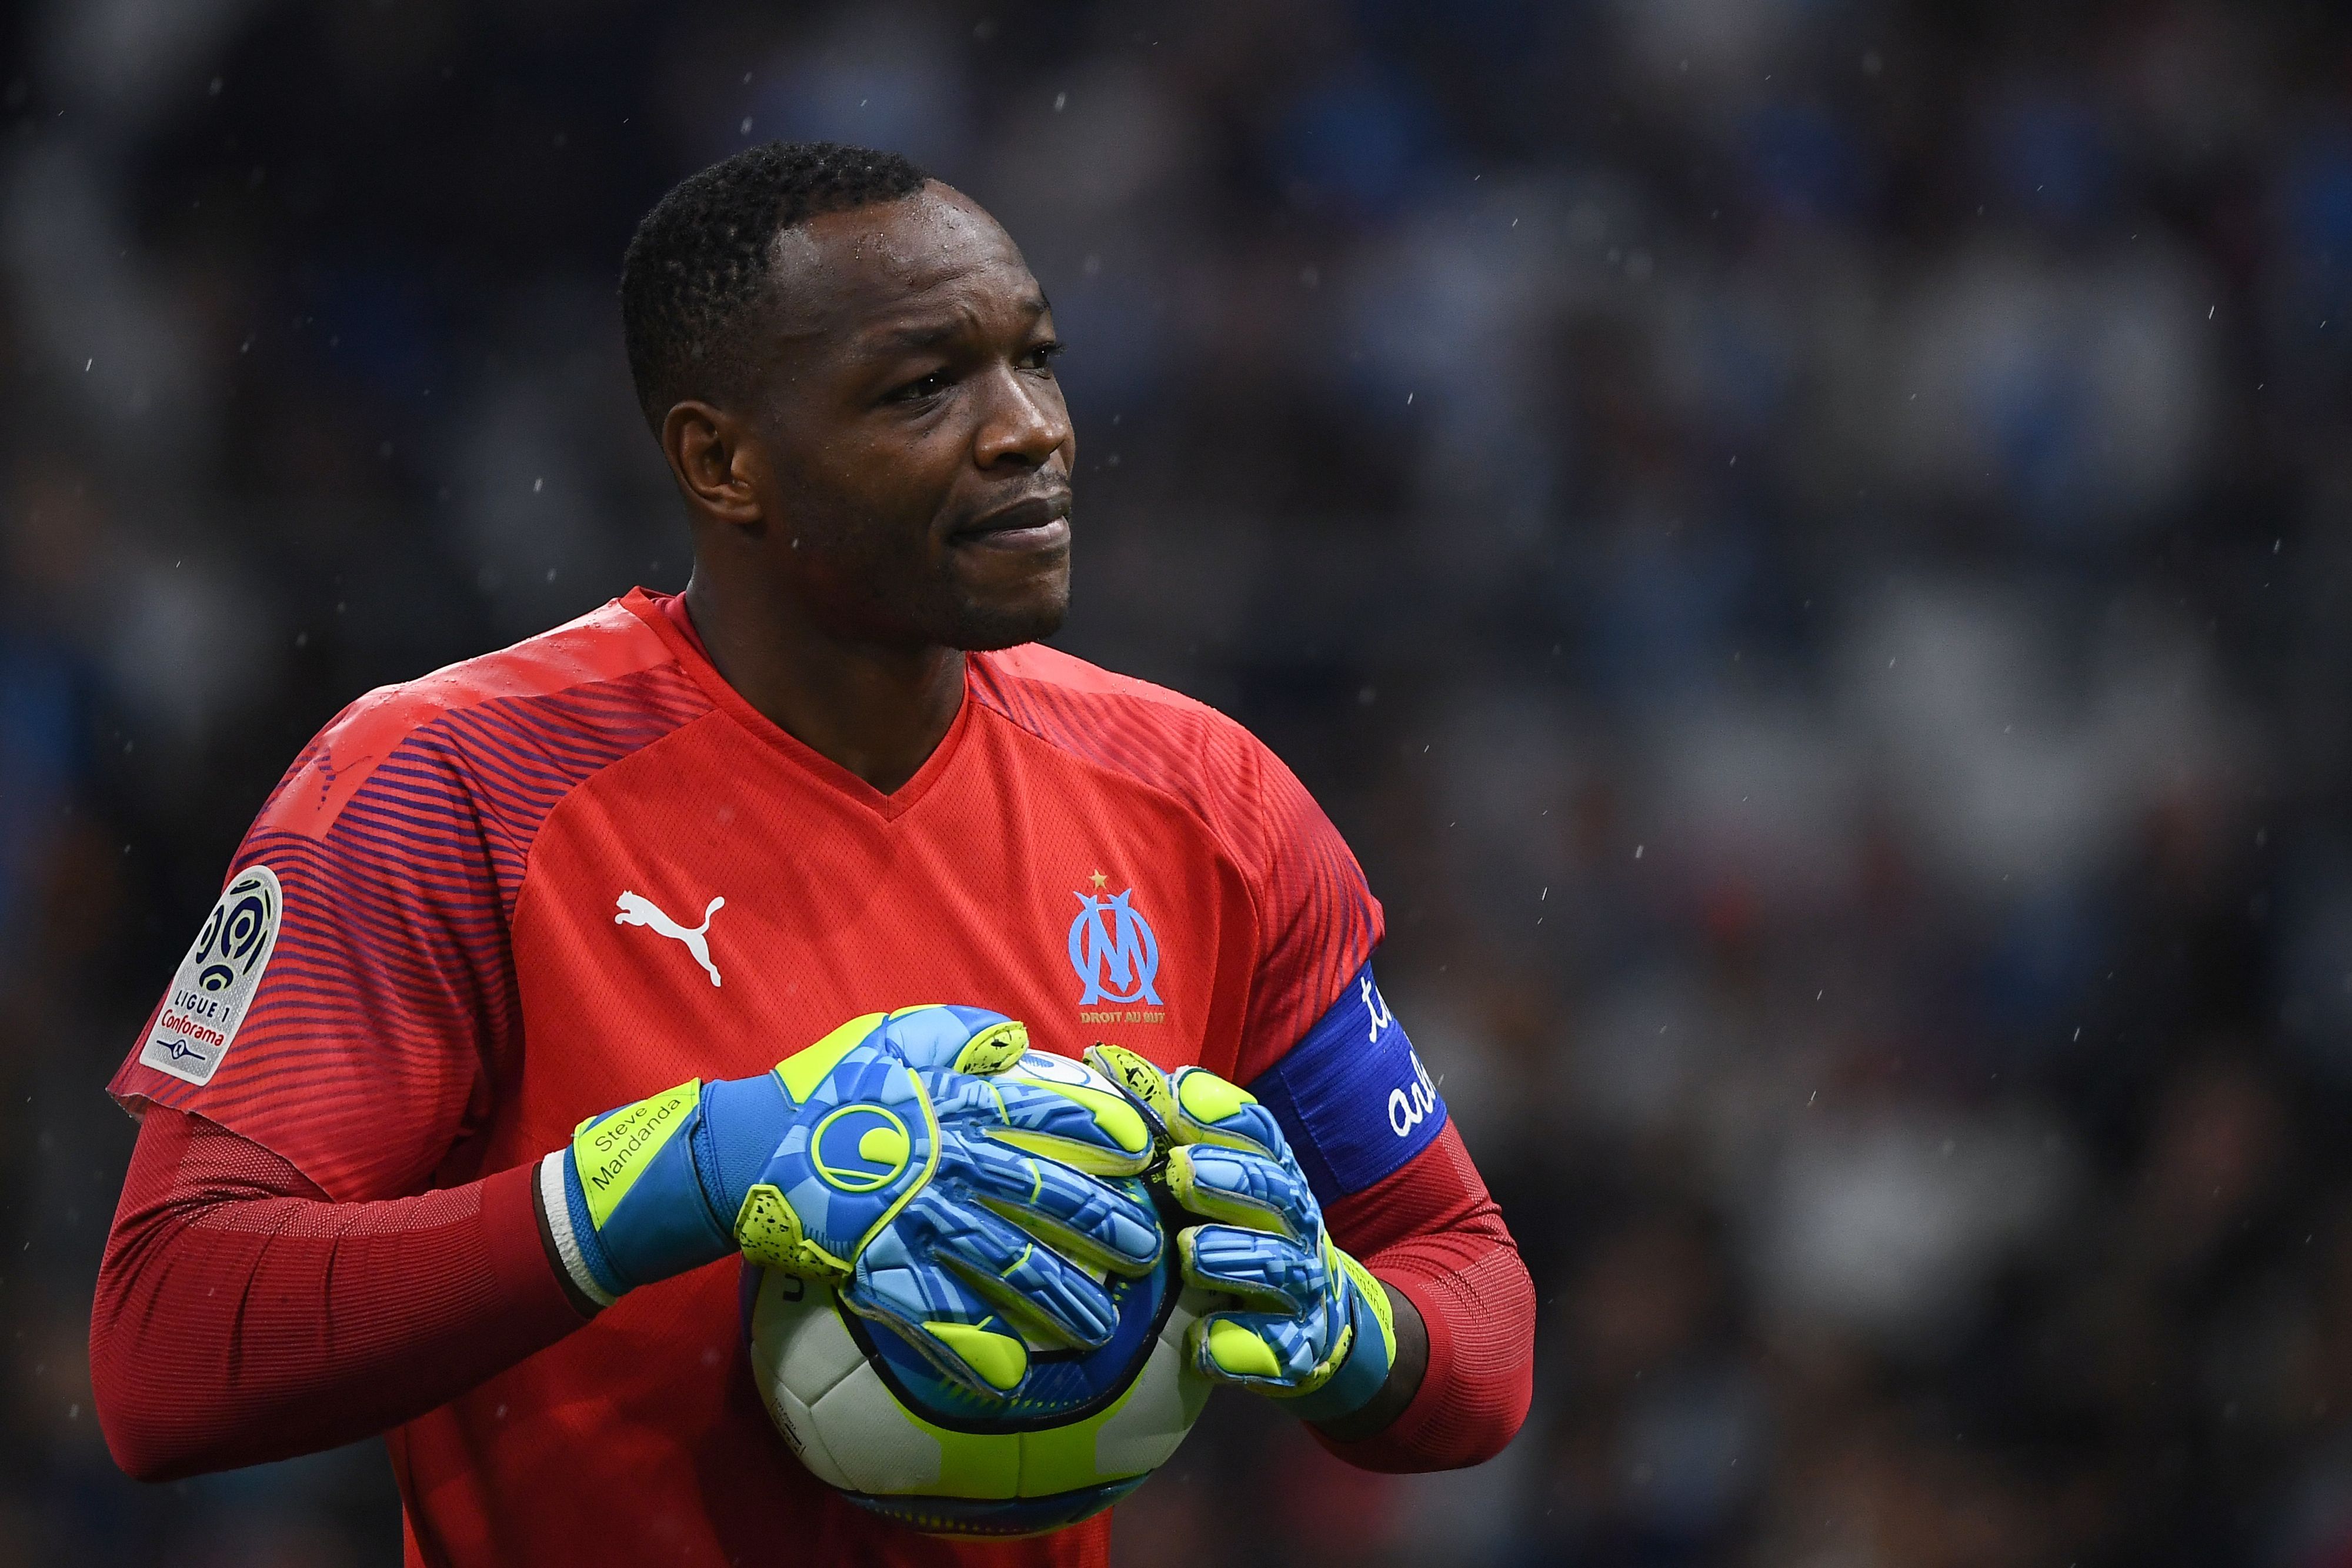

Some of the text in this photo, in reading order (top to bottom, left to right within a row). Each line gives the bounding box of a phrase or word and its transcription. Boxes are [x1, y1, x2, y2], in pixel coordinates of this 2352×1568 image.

[174, 989, 230, 1023] LIGUE 1
[1081, 1012, 1122, 1023] DROIT
[1125, 1012, 1141, 1023] AU
[161, 1009, 225, 1046] Conforama
[592, 1099, 681, 1191] Mandanda
[595, 1107, 648, 1152] Steve
